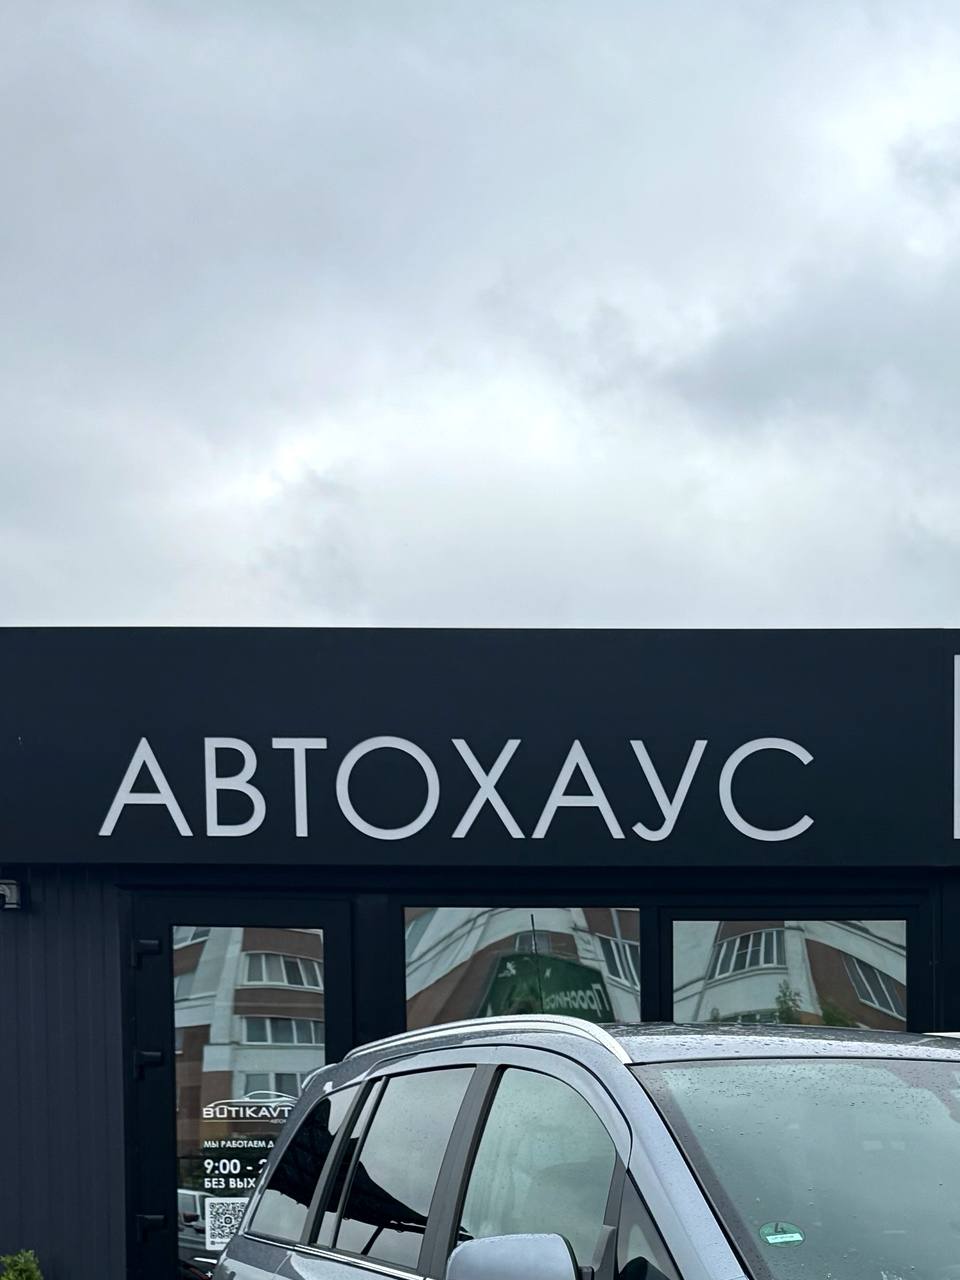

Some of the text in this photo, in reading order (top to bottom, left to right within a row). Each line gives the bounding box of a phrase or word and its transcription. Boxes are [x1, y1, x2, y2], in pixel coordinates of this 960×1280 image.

[98, 736, 814, 841] АВТОХАУС
[202, 1106, 292, 1119] BUTIKAVT
[203, 1140, 219, 1148] МЫ
[221, 1140, 266, 1148] РАБОТАЕМ
[203, 1159, 241, 1174] 9:00
[204, 1178, 226, 1189] БЕЗ
